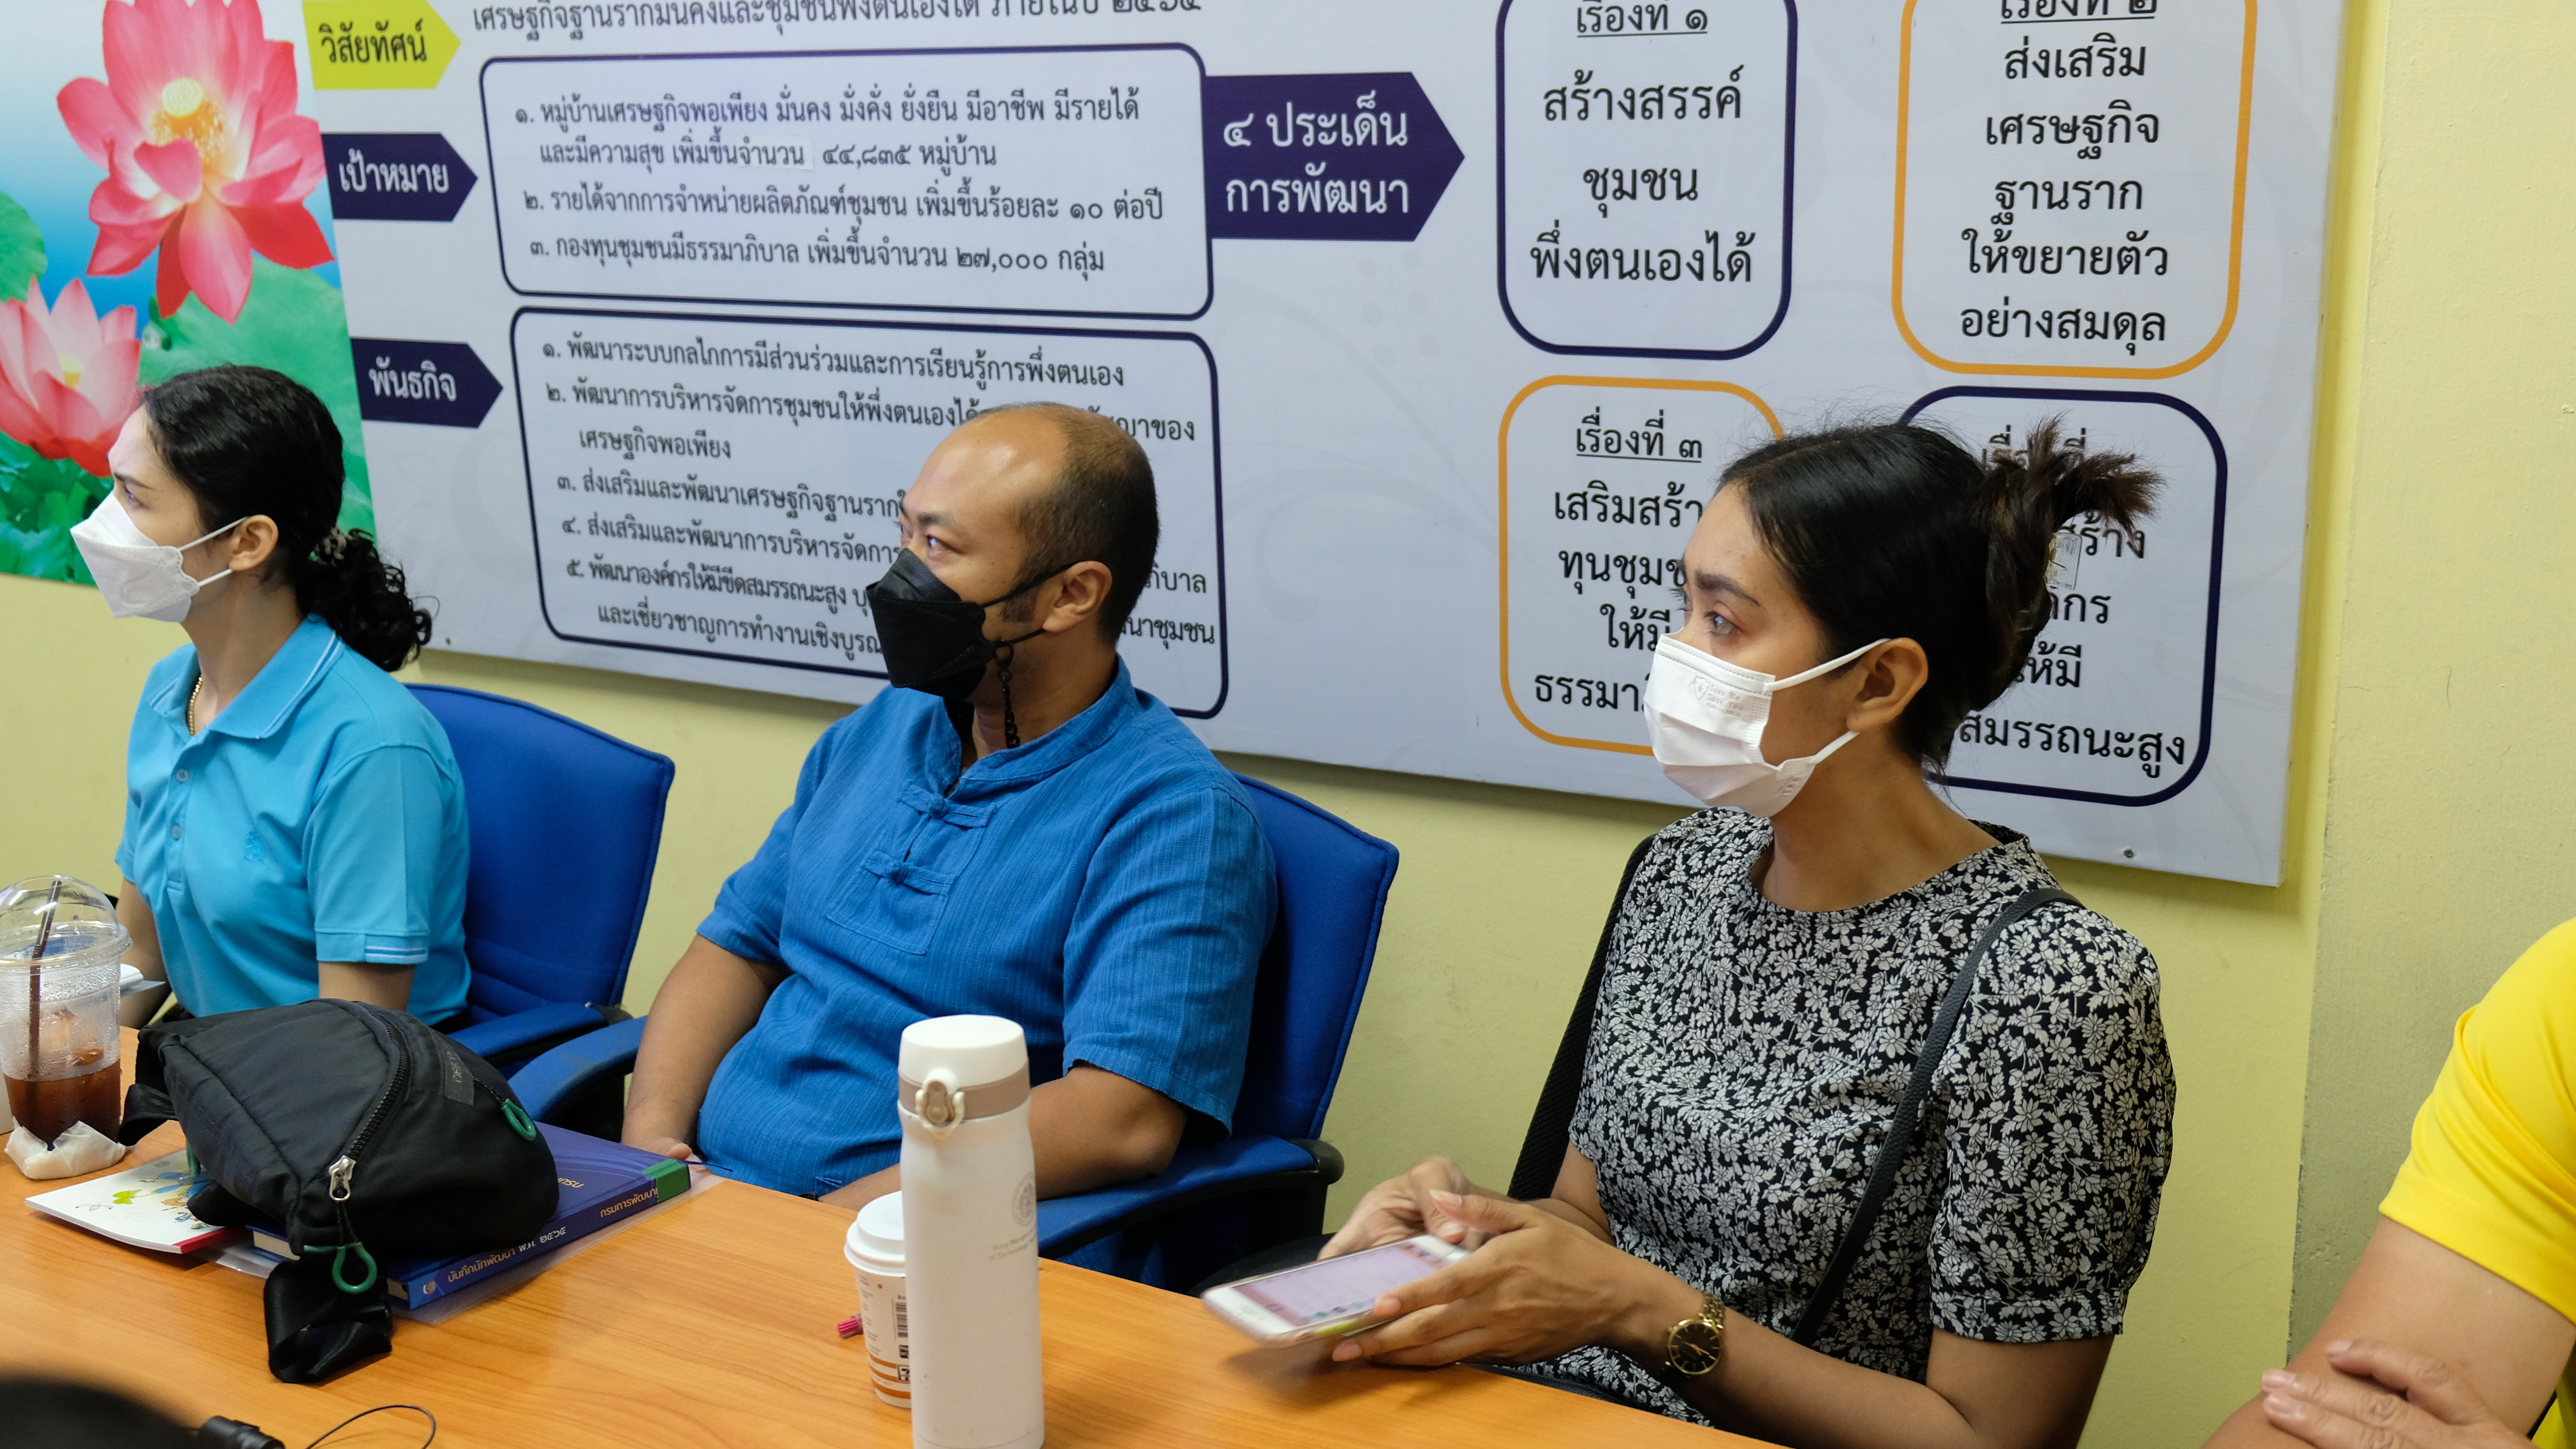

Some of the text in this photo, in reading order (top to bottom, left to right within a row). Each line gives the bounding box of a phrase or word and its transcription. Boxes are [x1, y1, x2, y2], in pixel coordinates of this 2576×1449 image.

[319, 18, 428, 65] วิสัยทัศน์
[1685, 9, 1708, 31] ๑
[2004, 32, 2147, 79] ส่งเสริม
[541, 93, 767, 133] หมู่บ้านเศรษฐกิจพอเพียง
[776, 84, 831, 122] มั่นคง
[839, 84, 892, 122] มั่งคั่ง
[901, 83, 958, 121] ยั่งยืน
[967, 86, 1044, 121] มีอาชีพ
[1054, 85, 1139, 121] มีรายได้
[1543, 64, 1744, 121] สร้างสรรค์
[1223, 90, 1408, 147] ๔ ประเด็น
[1986, 99, 2159, 160] เศรษฐกิจ
[338, 149, 451, 194] เป้าหมาย
[540, 136, 664, 174] และมีความสุข
[672, 126, 805, 166] เพิ่มขึ้นจำนวน
[918, 133, 997, 177] หมู่บ้าน
[551, 181, 907, 225] รายได้จากการจำหน่ายผลิตภัณฑ์ชุมชน
[916, 177, 1058, 220] เพิ่มขึ้นร้อยละ
[1069, 203, 1103, 220] ๑๐
[1114, 187, 1163, 221] ต่อปี
[1226, 161, 1409, 214] การพัฒนา
[1583, 167, 1698, 218] ชุมชน
[1990, 179, 2144, 226] ฐานราก
[556, 231, 799, 268] กองทุนชุมชนมีธรรมาภิบาล
[808, 226, 947, 267] เพิ่มขึ้นจำนวน
[1058, 240, 1105, 281] กลุ่ม
[1530, 219, 1756, 283] พึ่งตนเองได้
[1960, 228, 2168, 276] ให้ขยายตัว
[1960, 296, 2166, 356] อย่างสมดุล
[368, 356, 457, 402] พันธกิจ
[567, 331, 1123, 390] พัฒนาระบบกลไกการมีส่วนร่วมและการเรียนรู้การพึ่งตนเอง
[579, 425, 731, 460] เศรษฐกิจพอเพียง
[1576, 406, 1703, 459] เรื่องที่ ๓
[1554, 479, 1704, 528] เสริมสร้า
[588, 553, 846, 614] พัฒนาองค์กรให้มีขีดสมรรถนะสูง
[1558, 550, 1687, 599] ทุนชุมช
[598, 595, 882, 661] และเชี่ยวชาญการทำงานเชิงบูรณ
[1534, 673, 1647, 712] ธรรมา
[1959, 714, 2186, 778] สมรรถนะสูง
